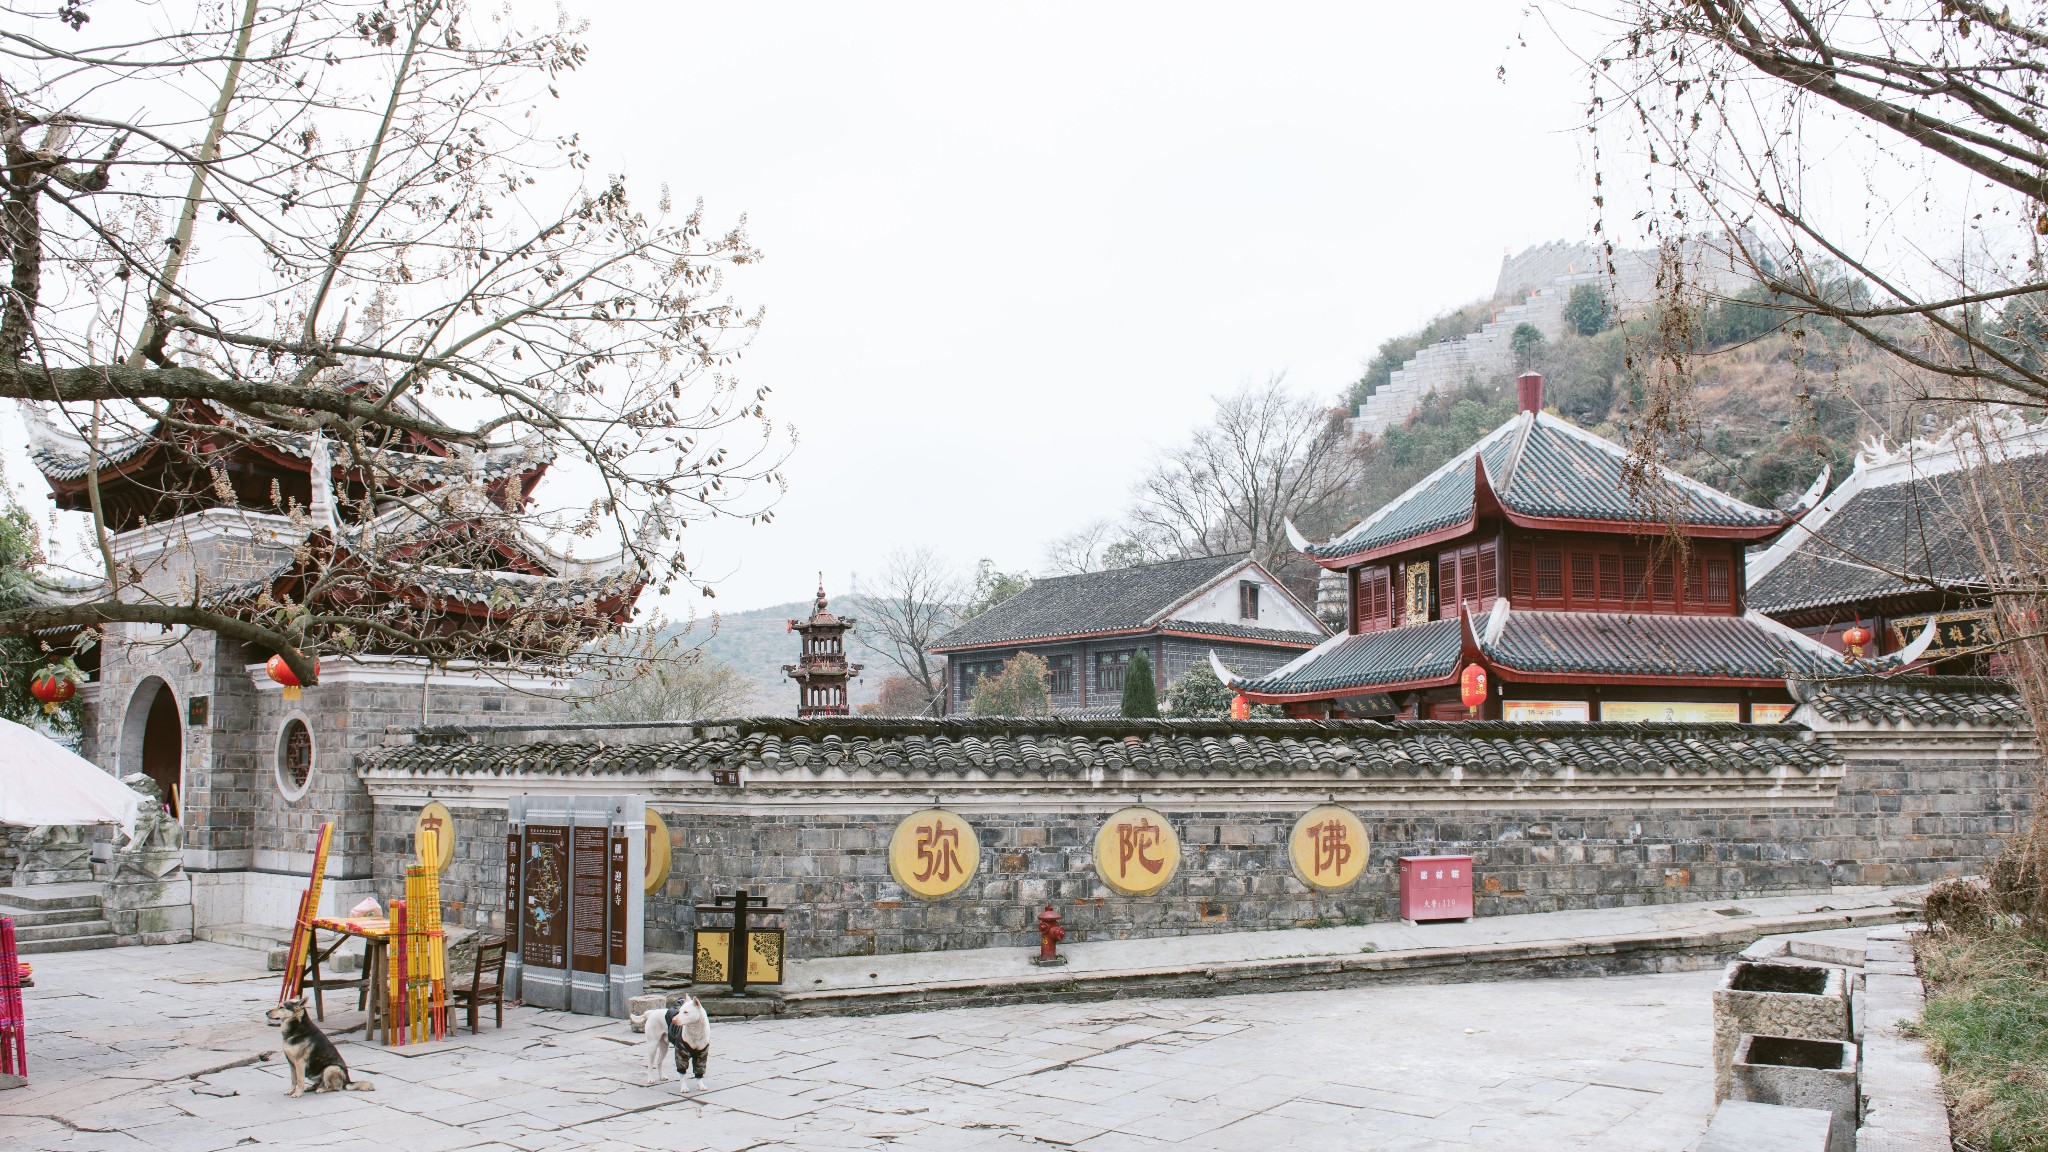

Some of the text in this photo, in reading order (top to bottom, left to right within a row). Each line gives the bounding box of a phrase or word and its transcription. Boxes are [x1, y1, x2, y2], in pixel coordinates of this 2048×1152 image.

[913, 817, 1352, 883] 弥 陀 佛
